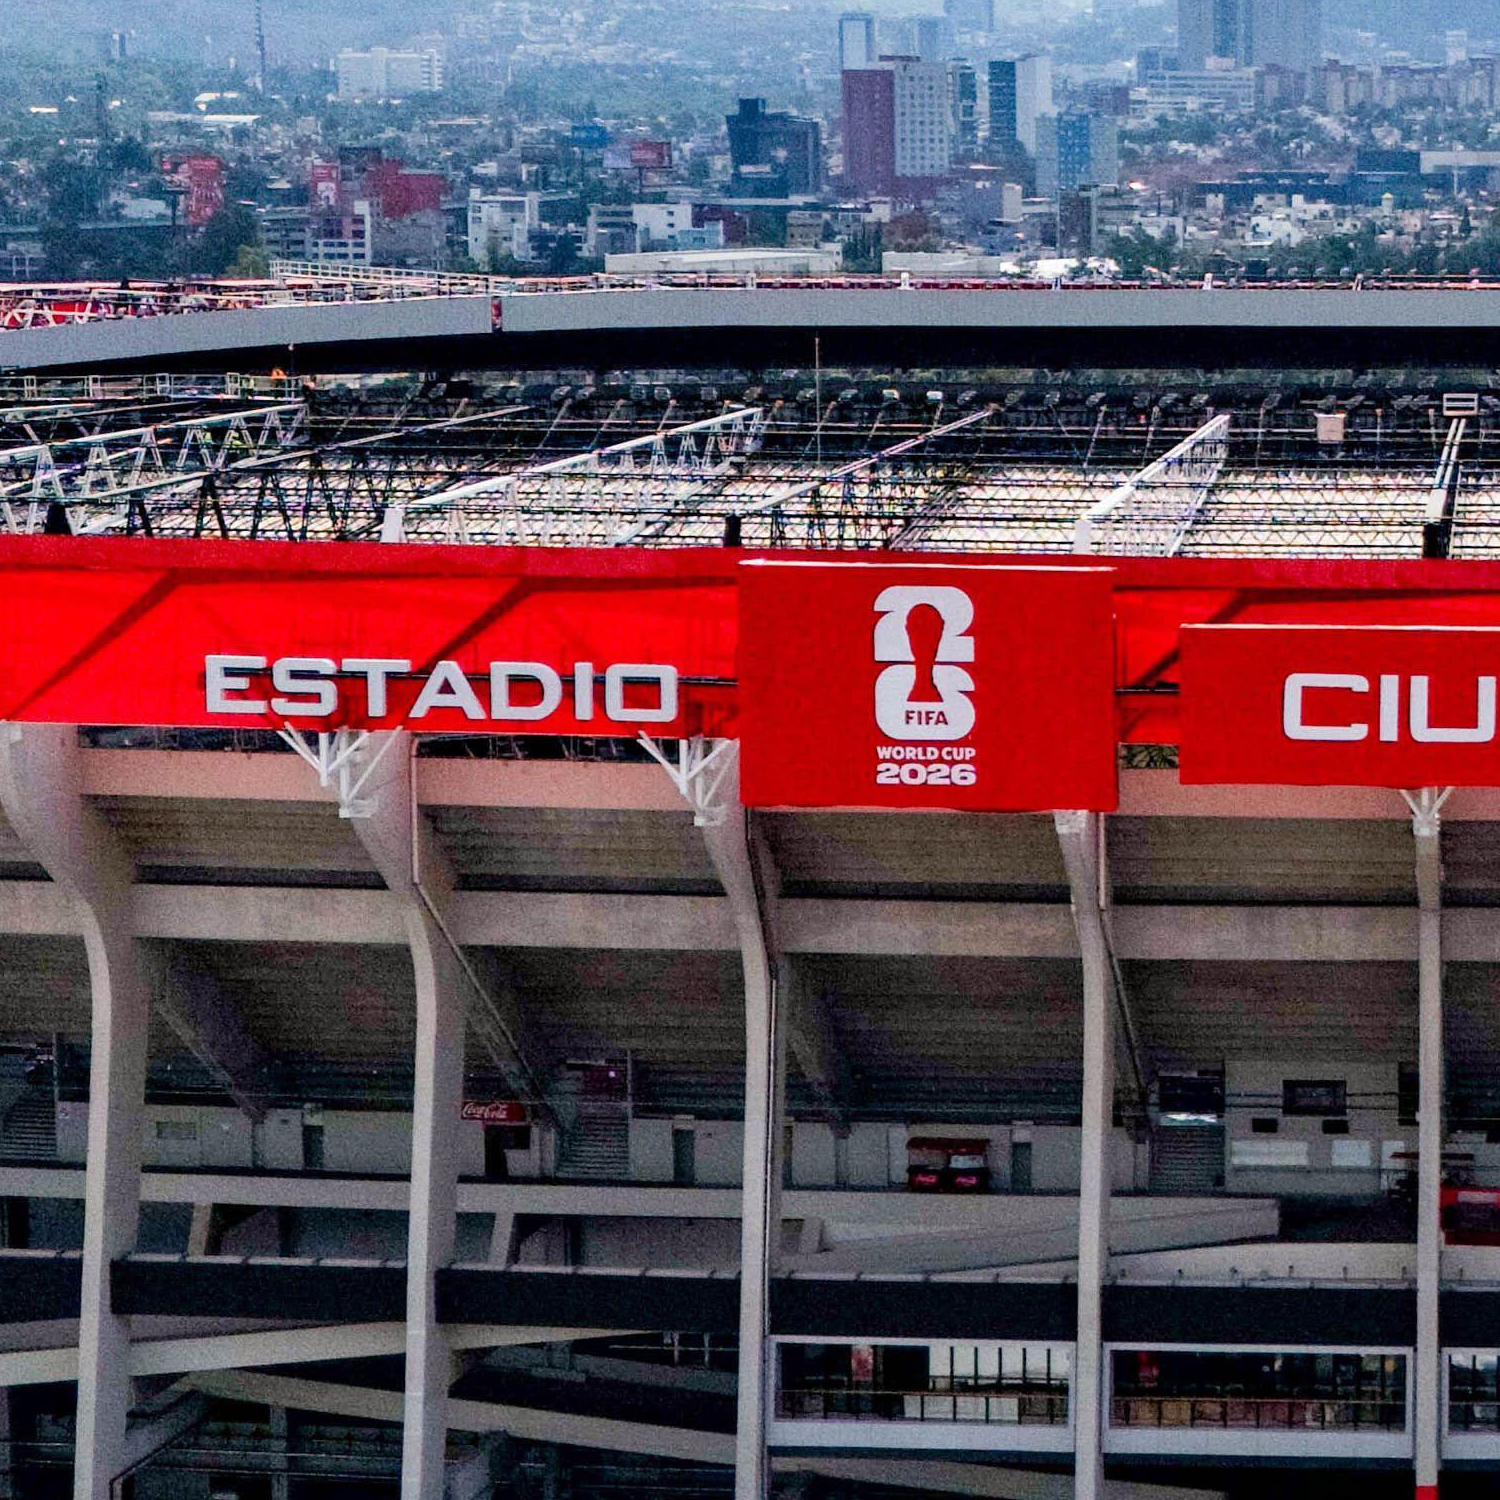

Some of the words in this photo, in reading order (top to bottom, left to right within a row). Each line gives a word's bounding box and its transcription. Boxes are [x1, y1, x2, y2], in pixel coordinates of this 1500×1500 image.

[204, 654, 678, 723] ESTADIO
[905, 710, 948, 725] FIFA
[876, 746, 939, 760] WORLD
[941, 747, 976, 760] CUP
[876, 762, 977, 786] 2026
